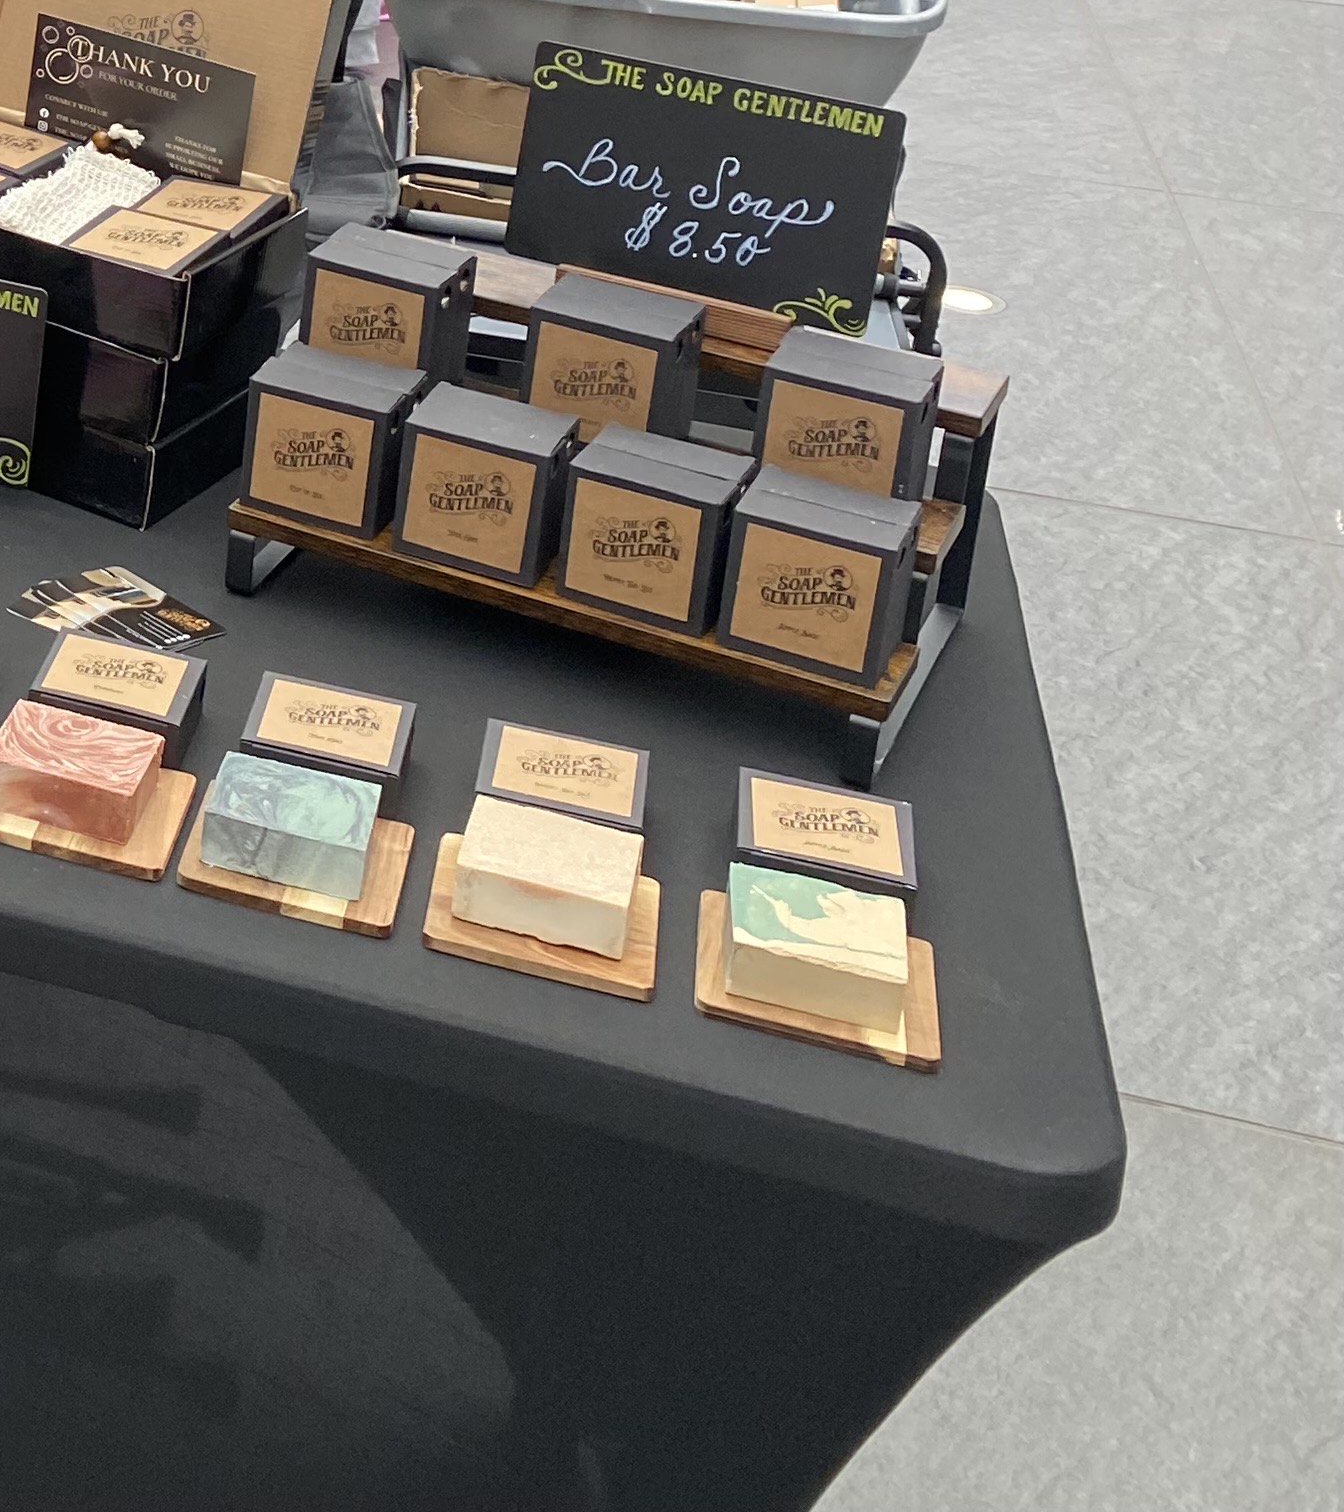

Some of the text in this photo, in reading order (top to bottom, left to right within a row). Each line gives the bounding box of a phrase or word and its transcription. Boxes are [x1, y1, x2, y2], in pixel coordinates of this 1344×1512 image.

[139, 15, 160, 28] THE
[73, 38, 212, 94] THANK YOU
[98, 71, 179, 102] FOR YOUR ORDER
[601, 59, 884, 138] THE SOAP GENTLEMEN
[542, 138, 835, 237] Bar Soap
[342, 314, 379, 328] SOAP
[329, 325, 405, 344] GENTLEMEN
[568, 369, 608, 383] SOAP
[554, 379, 637, 400] GENTLEMEN
[804, 428, 848, 443] SOAP
[287, 440, 325, 454] SOAP
[788, 440, 880, 460] GENTLEMEN
[274, 451, 354, 470] GENTLEMEN
[444, 483, 483, 496] SOAP
[429, 494, 514, 515] GENTLEMEN
[607, 529, 648, 543] SOAP
[592, 539, 680, 563] GENTLEMEN
[778, 576, 823, 591] SOAP
[761, 587, 857, 610] GENTLEMEN
[76, 665, 164, 684] GENTLEMEN
[92, 660, 136, 671] SOAP
[288, 712, 381, 731] GENTLEMEN
[304, 708, 349, 717] SOAP
[521, 762, 618, 782] GENTLEMEN
[538, 758, 583, 768] SOAP
[794, 811, 840, 822] SOAP
[779, 817, 880, 838] GENTLEMEN
